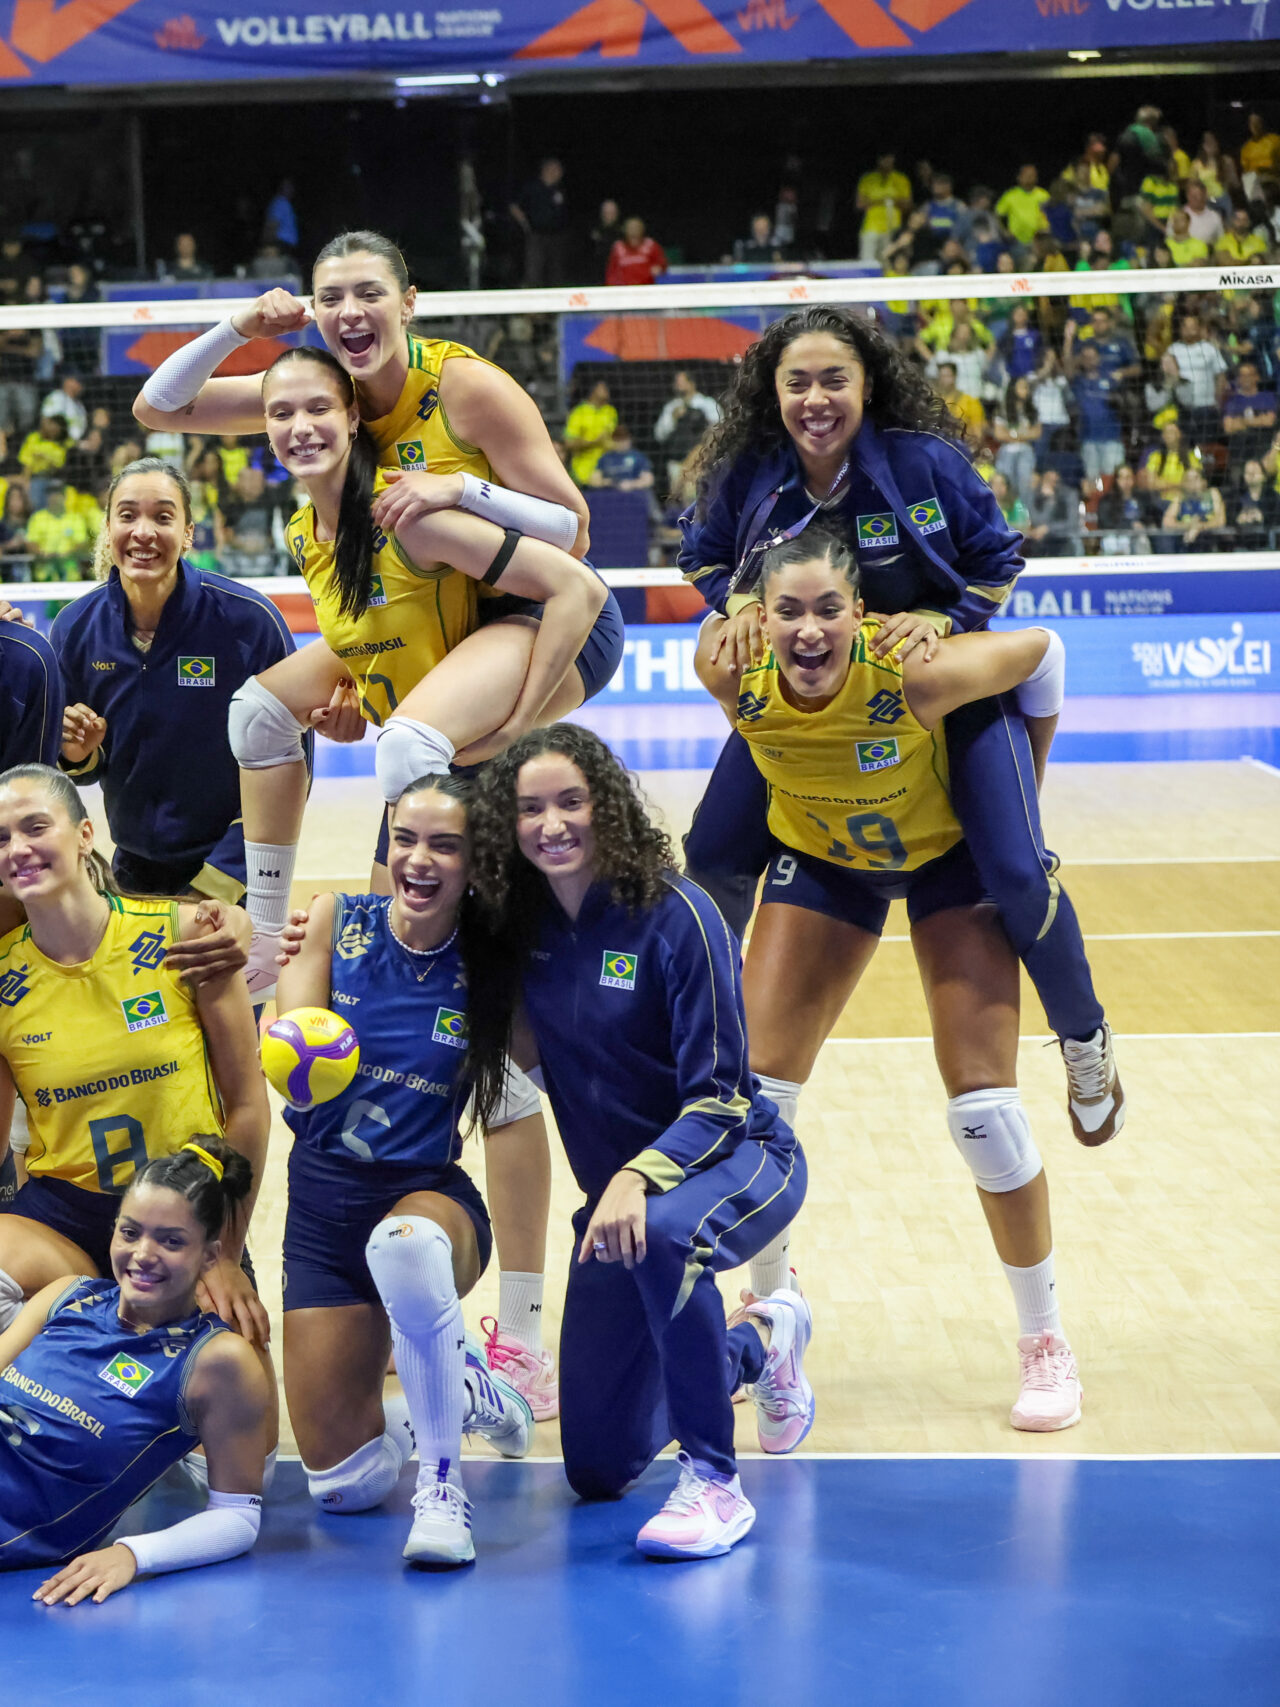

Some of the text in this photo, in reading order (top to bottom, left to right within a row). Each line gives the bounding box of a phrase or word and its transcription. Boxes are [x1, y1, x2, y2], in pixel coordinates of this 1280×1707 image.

[216, 11, 433, 46] VOLLEYBALL
[401, 463, 427, 471] BRASIL
[922, 521, 946, 535] ASIL
[860, 536, 898, 547] BRASIL
[368, 597, 387, 606] ASIL
[365, 636, 407, 654] BRASIL
[91, 661, 116, 672] VOLT
[178, 677, 214, 687] BRASIL
[861, 758, 899, 772] BRASIL
[856, 787, 908, 806] BRASIL
[806, 812, 909, 869] 19
[600, 976, 634, 990] BRASIL
[332, 990, 360, 1006] VOLT
[128, 1014, 169, 1032] BRASIL
[22, 1031, 53, 1046] VOLT
[53, 1060, 181, 1103] BANCO DO BRASIL
[382, 1069, 405, 1084] DO
[405, 1073, 450, 1098] BRASIL
[100, 1371, 134, 1397] BRASIL
[4, 1365, 43, 1397] BANCO
[40, 1389, 61, 1408] DO
[56, 1396, 106, 1440] BRASIL
